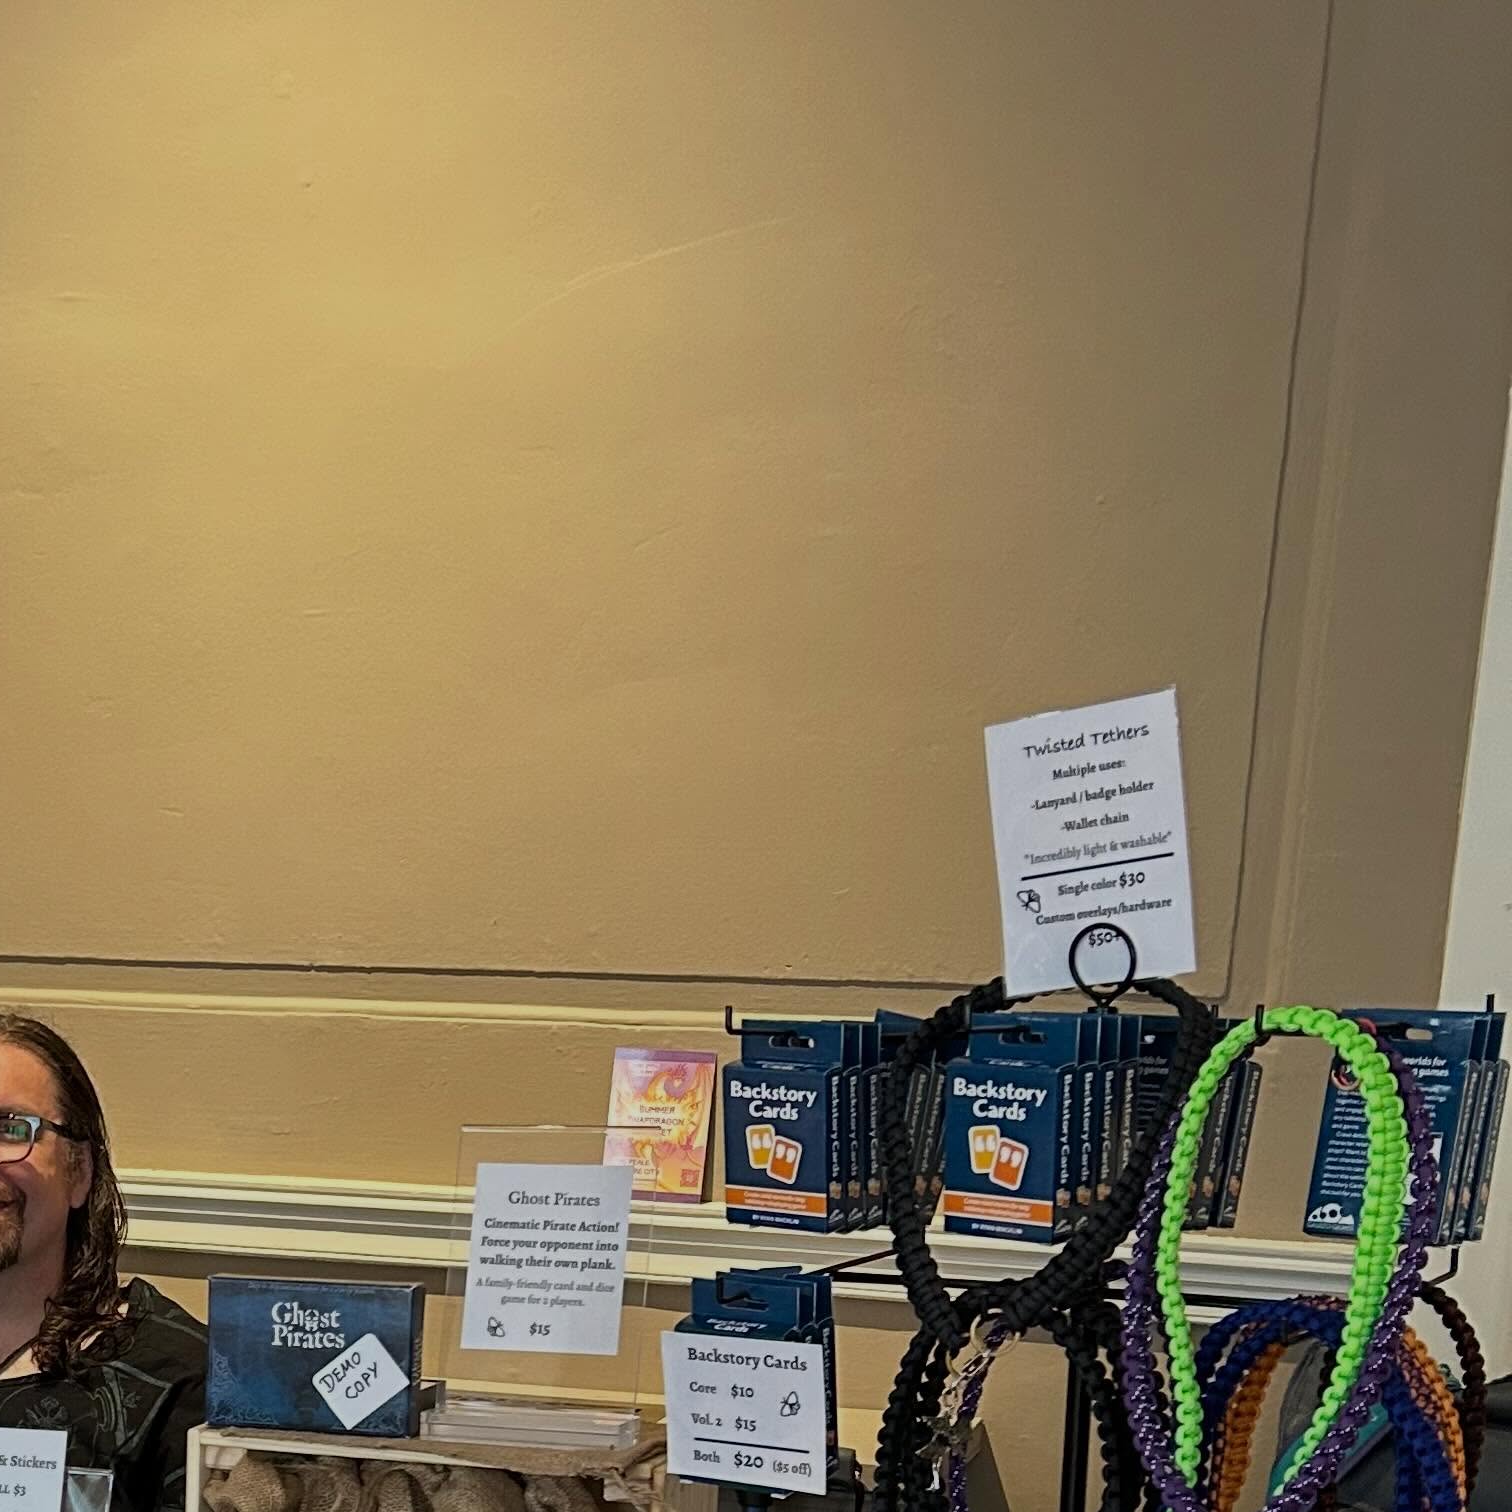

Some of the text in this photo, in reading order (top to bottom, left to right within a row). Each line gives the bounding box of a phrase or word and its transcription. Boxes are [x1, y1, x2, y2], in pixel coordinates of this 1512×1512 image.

[1023, 723, 1150, 758] Twisted Tethers
[1052, 758, 1126, 780] Multiple uses:
[1100, 811, 1129, 827] chain
[1057, 871, 1145, 896] Single color $30
[1035, 911, 1076, 926] Custom
[730, 1080, 818, 1108] Backstory
[953, 1077, 1047, 1107] Backstory
[748, 1101, 799, 1121] Cards
[972, 1099, 1026, 1121] Cards
[508, 1190, 601, 1208] Ghost Pirates
[484, 1217, 620, 1233] Cinematic Pirate Action!
[480, 1236, 619, 1253] Force your opponent into
[479, 1254, 616, 1273] walking their own plank.
[271, 1301, 341, 1332] Ghost
[271, 1324, 345, 1350] Pirates
[529, 1321, 551, 1336] $15
[687, 1347, 808, 1372] Backstory Cards
[319, 1351, 362, 1394] DEMO
[345, 1361, 379, 1401] COPY
[689, 1381, 755, 1399] Core $10
[691, 1412, 757, 1432] Vol. 2 $15
[10, 1455, 58, 1471] Stickers
[693, 1449, 721, 1464] Both
[734, 1451, 764, 1470] $20
[13, 1482, 27, 1497] $3
